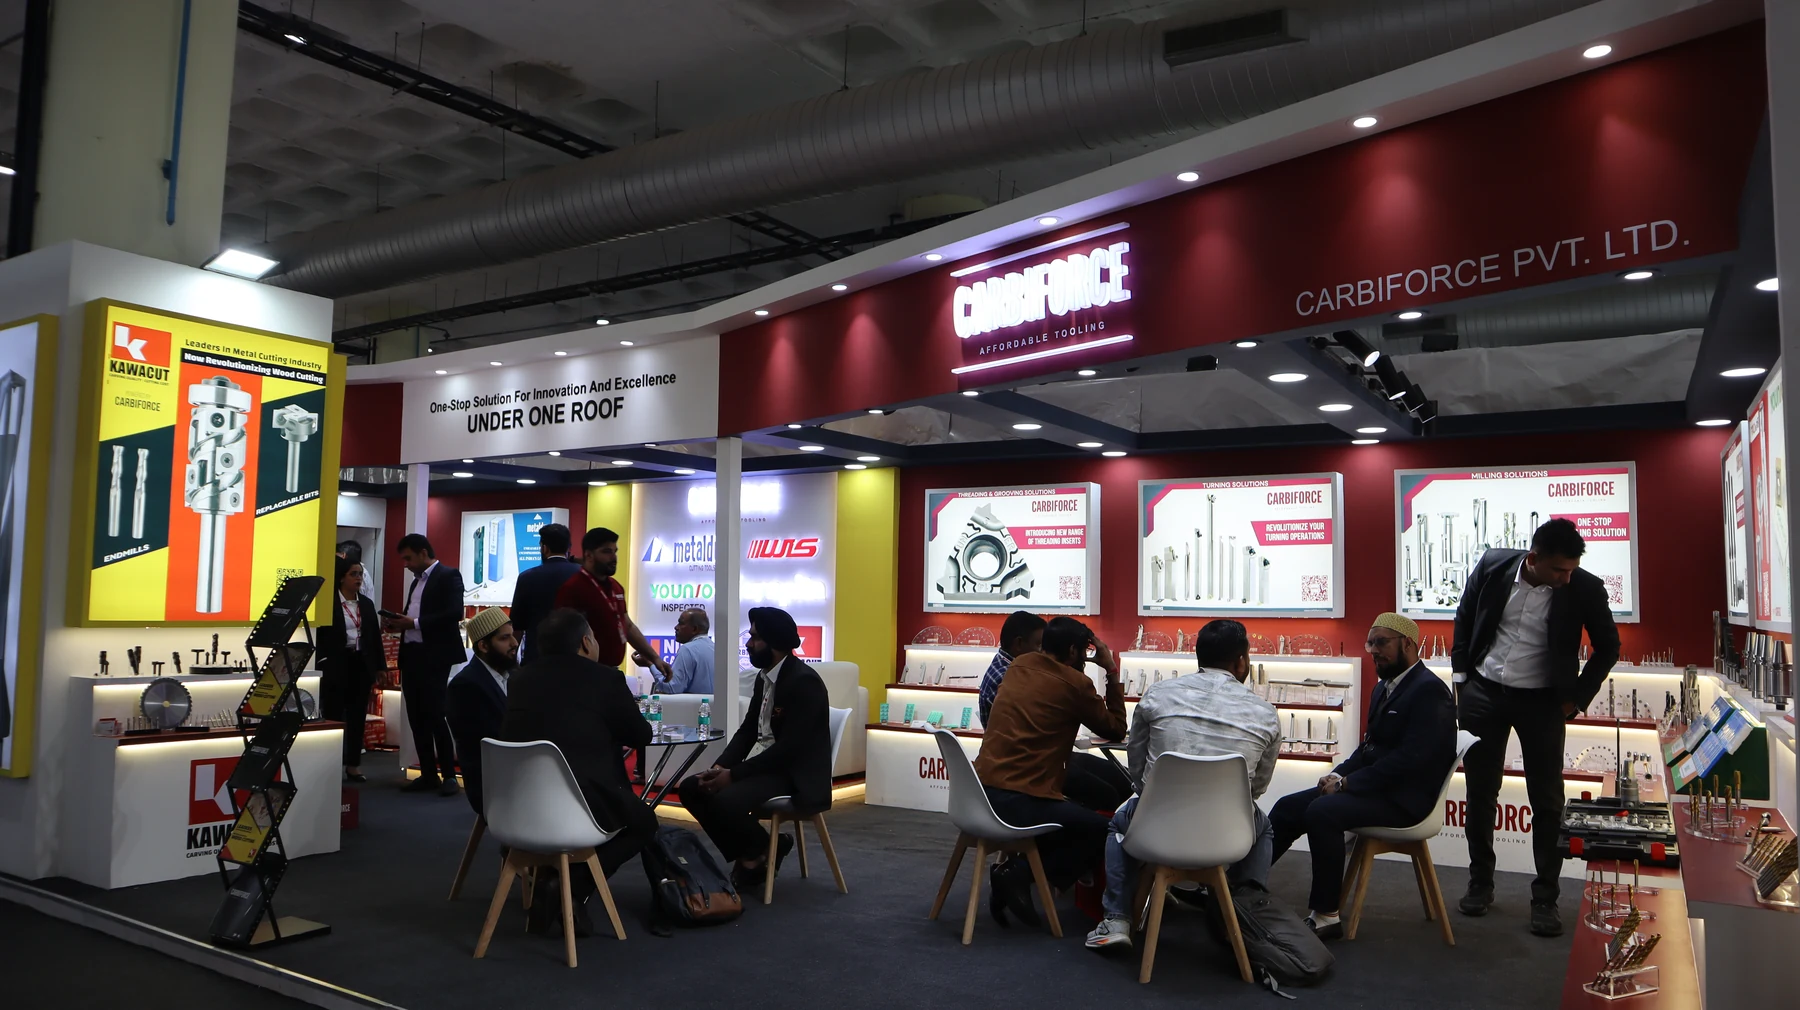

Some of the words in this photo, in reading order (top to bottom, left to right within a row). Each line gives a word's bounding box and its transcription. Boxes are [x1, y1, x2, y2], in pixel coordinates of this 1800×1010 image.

[1295, 253, 1501, 316] CARBIFORCE
[1514, 236, 1590, 278] PVT.
[1605, 218, 1690, 260] LTD.
[980, 333, 1048, 355] AFFORDABLE
[1054, 321, 1105, 338] TOOLING
[186, 339, 220, 351] Leaders
[233, 348, 256, 358] Metal
[258, 352, 288, 364] Cutting
[290, 358, 322, 370] Industry
[110, 360, 170, 381] KAWACUT
[184, 352, 204, 362] Now
[206, 356, 271, 376] Revolutionizing
[272, 368, 295, 378] Wood
[296, 372, 324, 384] Cutting
[430, 398, 471, 414] One-Stop
[473, 394, 512, 408] Solution
[514, 390, 531, 402] For
[533, 384, 586, 400] Innovation
[589, 379, 611, 393] And
[614, 373, 676, 390] Excellence
[114, 396, 160, 412] CARBIFORCE
[468, 410, 524, 433] UNDER
[528, 403, 565, 426] ONE
[571, 396, 625, 422] ROOF
[1504, 470, 1548, 479] SOLUTIONS
[1267, 490, 1322, 506] CARBIFORCE
[1548, 481, 1615, 498] CARBIFORCE
[256, 494, 304, 515] REPLACEABLE
[304, 490, 319, 501] BITS
[1032, 499, 1078, 513] CARBIFORCE
[1266, 523, 1308, 532] REVOLUTIONIZE
[1309, 522, 1325, 531] YOUR
[1577, 517, 1612, 527] ONE-STOP
[1265, 533, 1289, 541] TURNING
[1290, 532, 1325, 541] OPERATIONS
[1592, 528, 1626, 537] SOLUTION
[104, 544, 150, 562] ENDMILLS
[186, 850, 212, 858] CARVING
